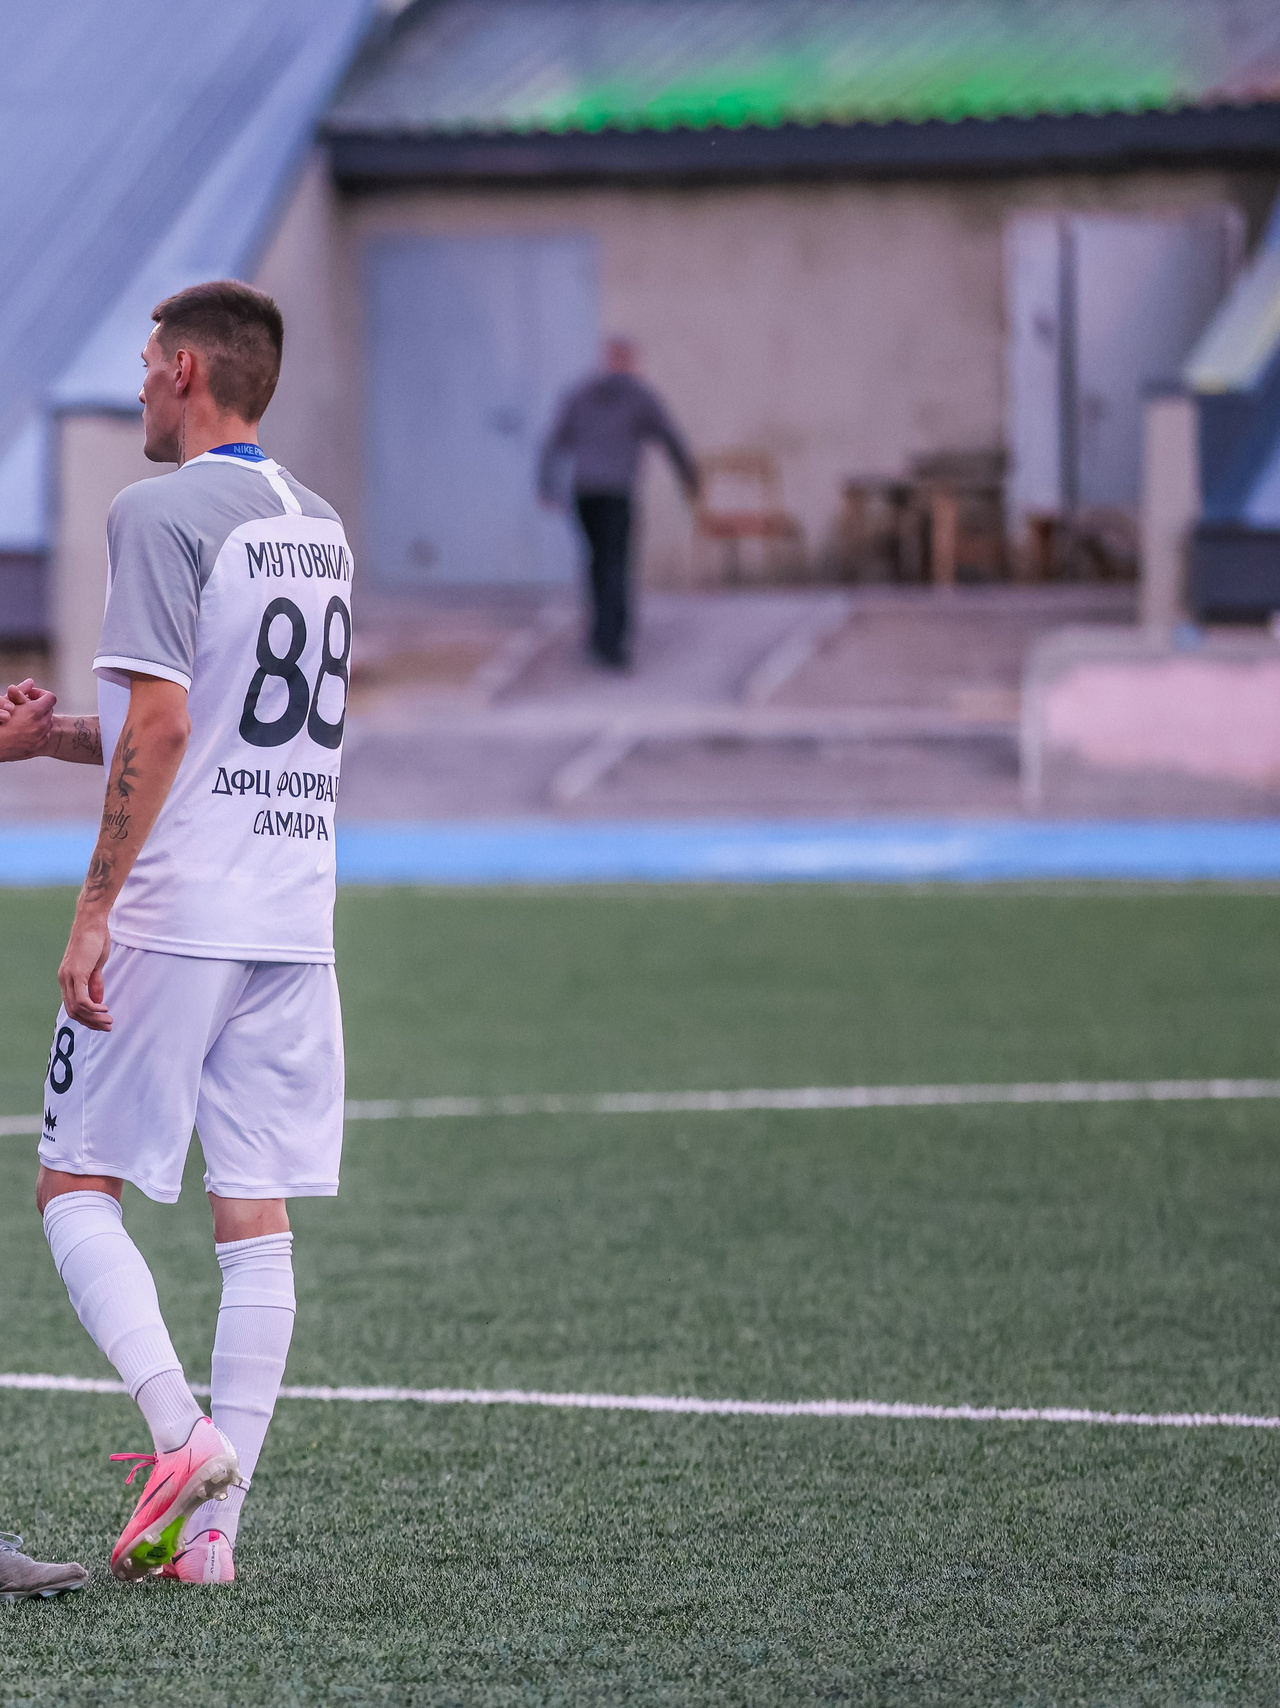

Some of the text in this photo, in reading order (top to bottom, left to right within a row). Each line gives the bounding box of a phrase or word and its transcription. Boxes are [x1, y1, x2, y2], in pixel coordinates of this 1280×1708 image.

[233, 445, 266, 458] NIKE PR
[238, 595, 352, 750] 88
[211, 767, 340, 803] ДФЦ ФОРВАР
[253, 809, 329, 841] САМАРА
[47, 1026, 75, 1094] 8
